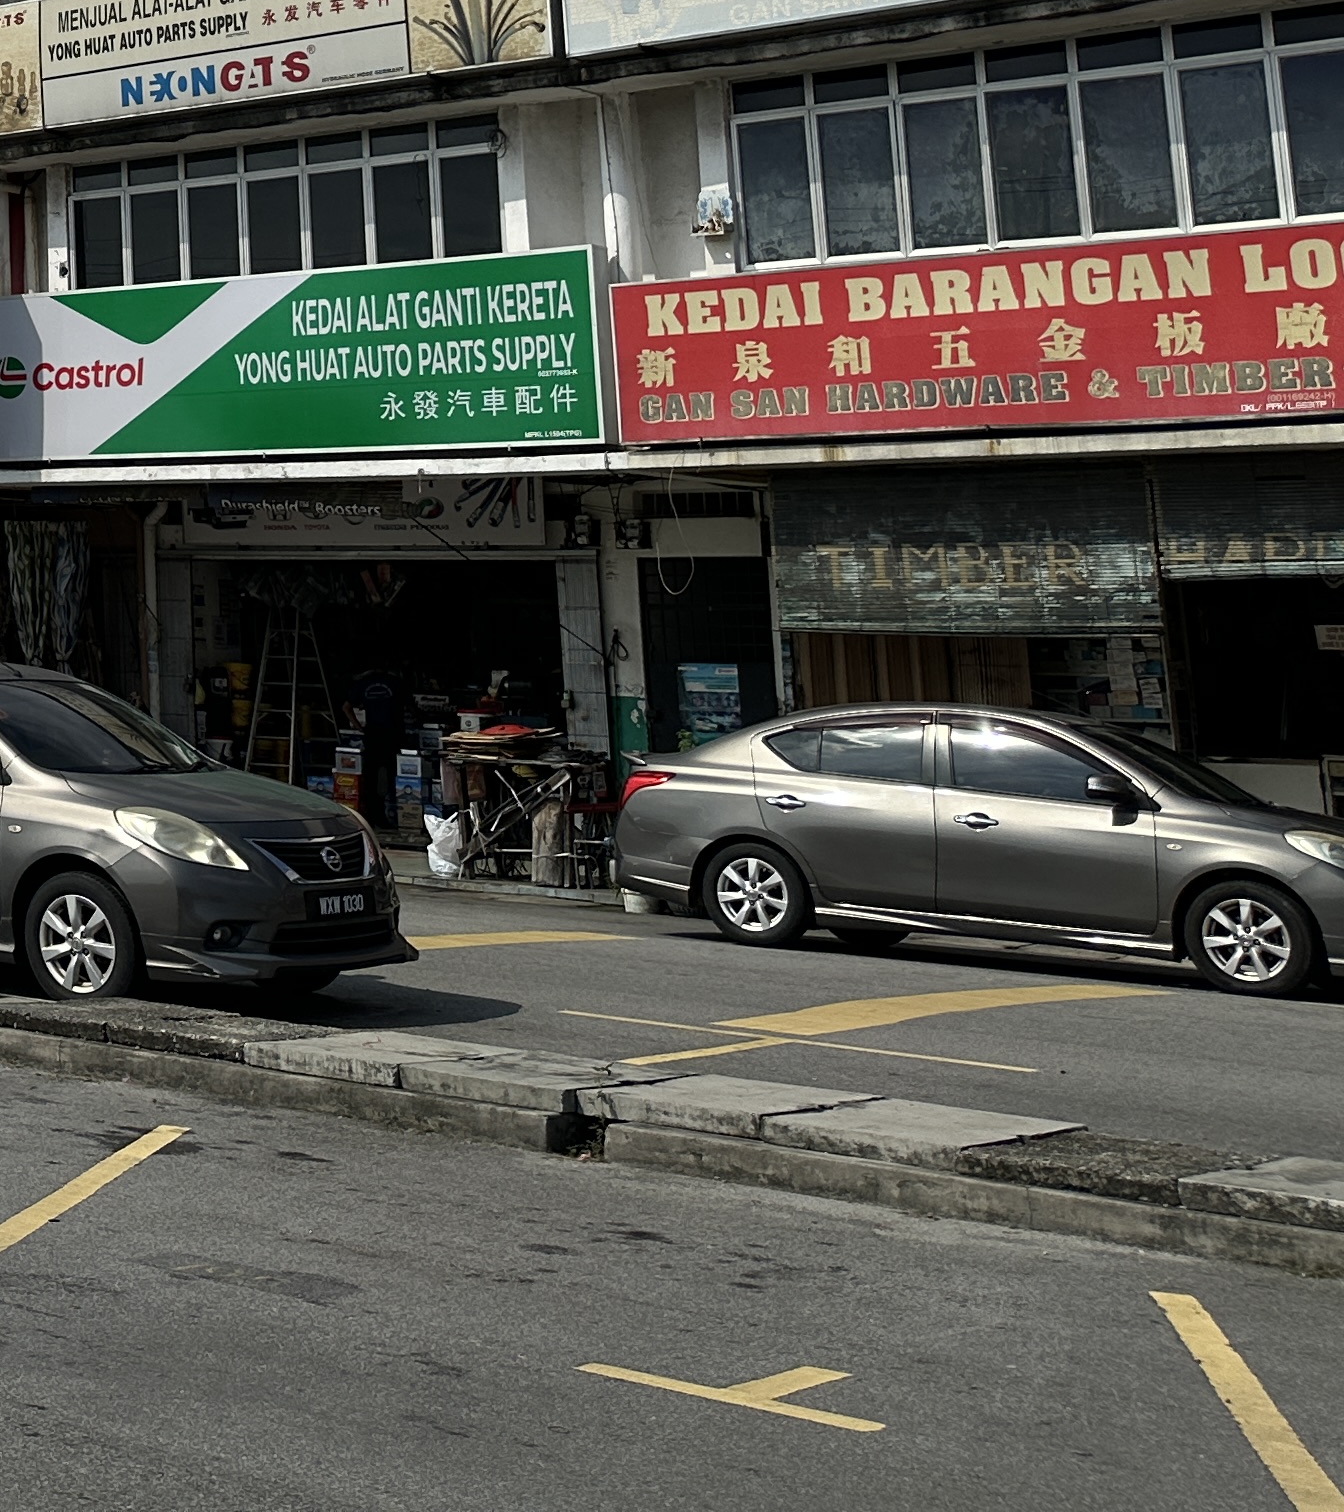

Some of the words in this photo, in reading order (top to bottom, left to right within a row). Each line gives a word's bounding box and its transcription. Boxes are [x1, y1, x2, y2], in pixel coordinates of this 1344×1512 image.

[48, 42, 81, 62] YONG
[84, 34, 116, 57] HUAT
[119, 27, 153, 51] AUTO
[156, 21, 196, 44] PARTS
[199, 11, 249, 37] SUPPLY
[58, 2, 127, 33] MENJUAL
[729, 0, 791, 25] GAN
[292, 297, 352, 336] KEDAI
[356, 292, 410, 332] ALAT
[414, 286, 481, 328] GANTI
[487, 280, 574, 324] KERETA
[644, 281, 823, 336] KEDAI
[844, 248, 1212, 323] BARANGAN
[1238, 238, 1344, 294] LO
[234, 350, 291, 385] YONG
[296, 346, 350, 381] HUAT
[354, 343, 412, 378] AUTO
[418, 339, 487, 375] PARTS
[492, 333, 575, 371] SUPPLY
[636, 302, 1329, 387] 新泉和五金板廠
[31, 357, 144, 392] Castrol
[638, 392, 714, 424] GAN
[730, 386, 809, 419] SAN
[826, 371, 1069, 414] HARDWARE
[1086, 368, 1119, 398] &
[1136, 356, 1334, 398] TIMBER
[379, 383, 578, 420] 永發汽車配件
[315, 501, 381, 516] Boosters
[813, 541, 1089, 591] TIMBER
[319, 896, 340, 915] WXW
[343, 893, 364, 913] 1030
